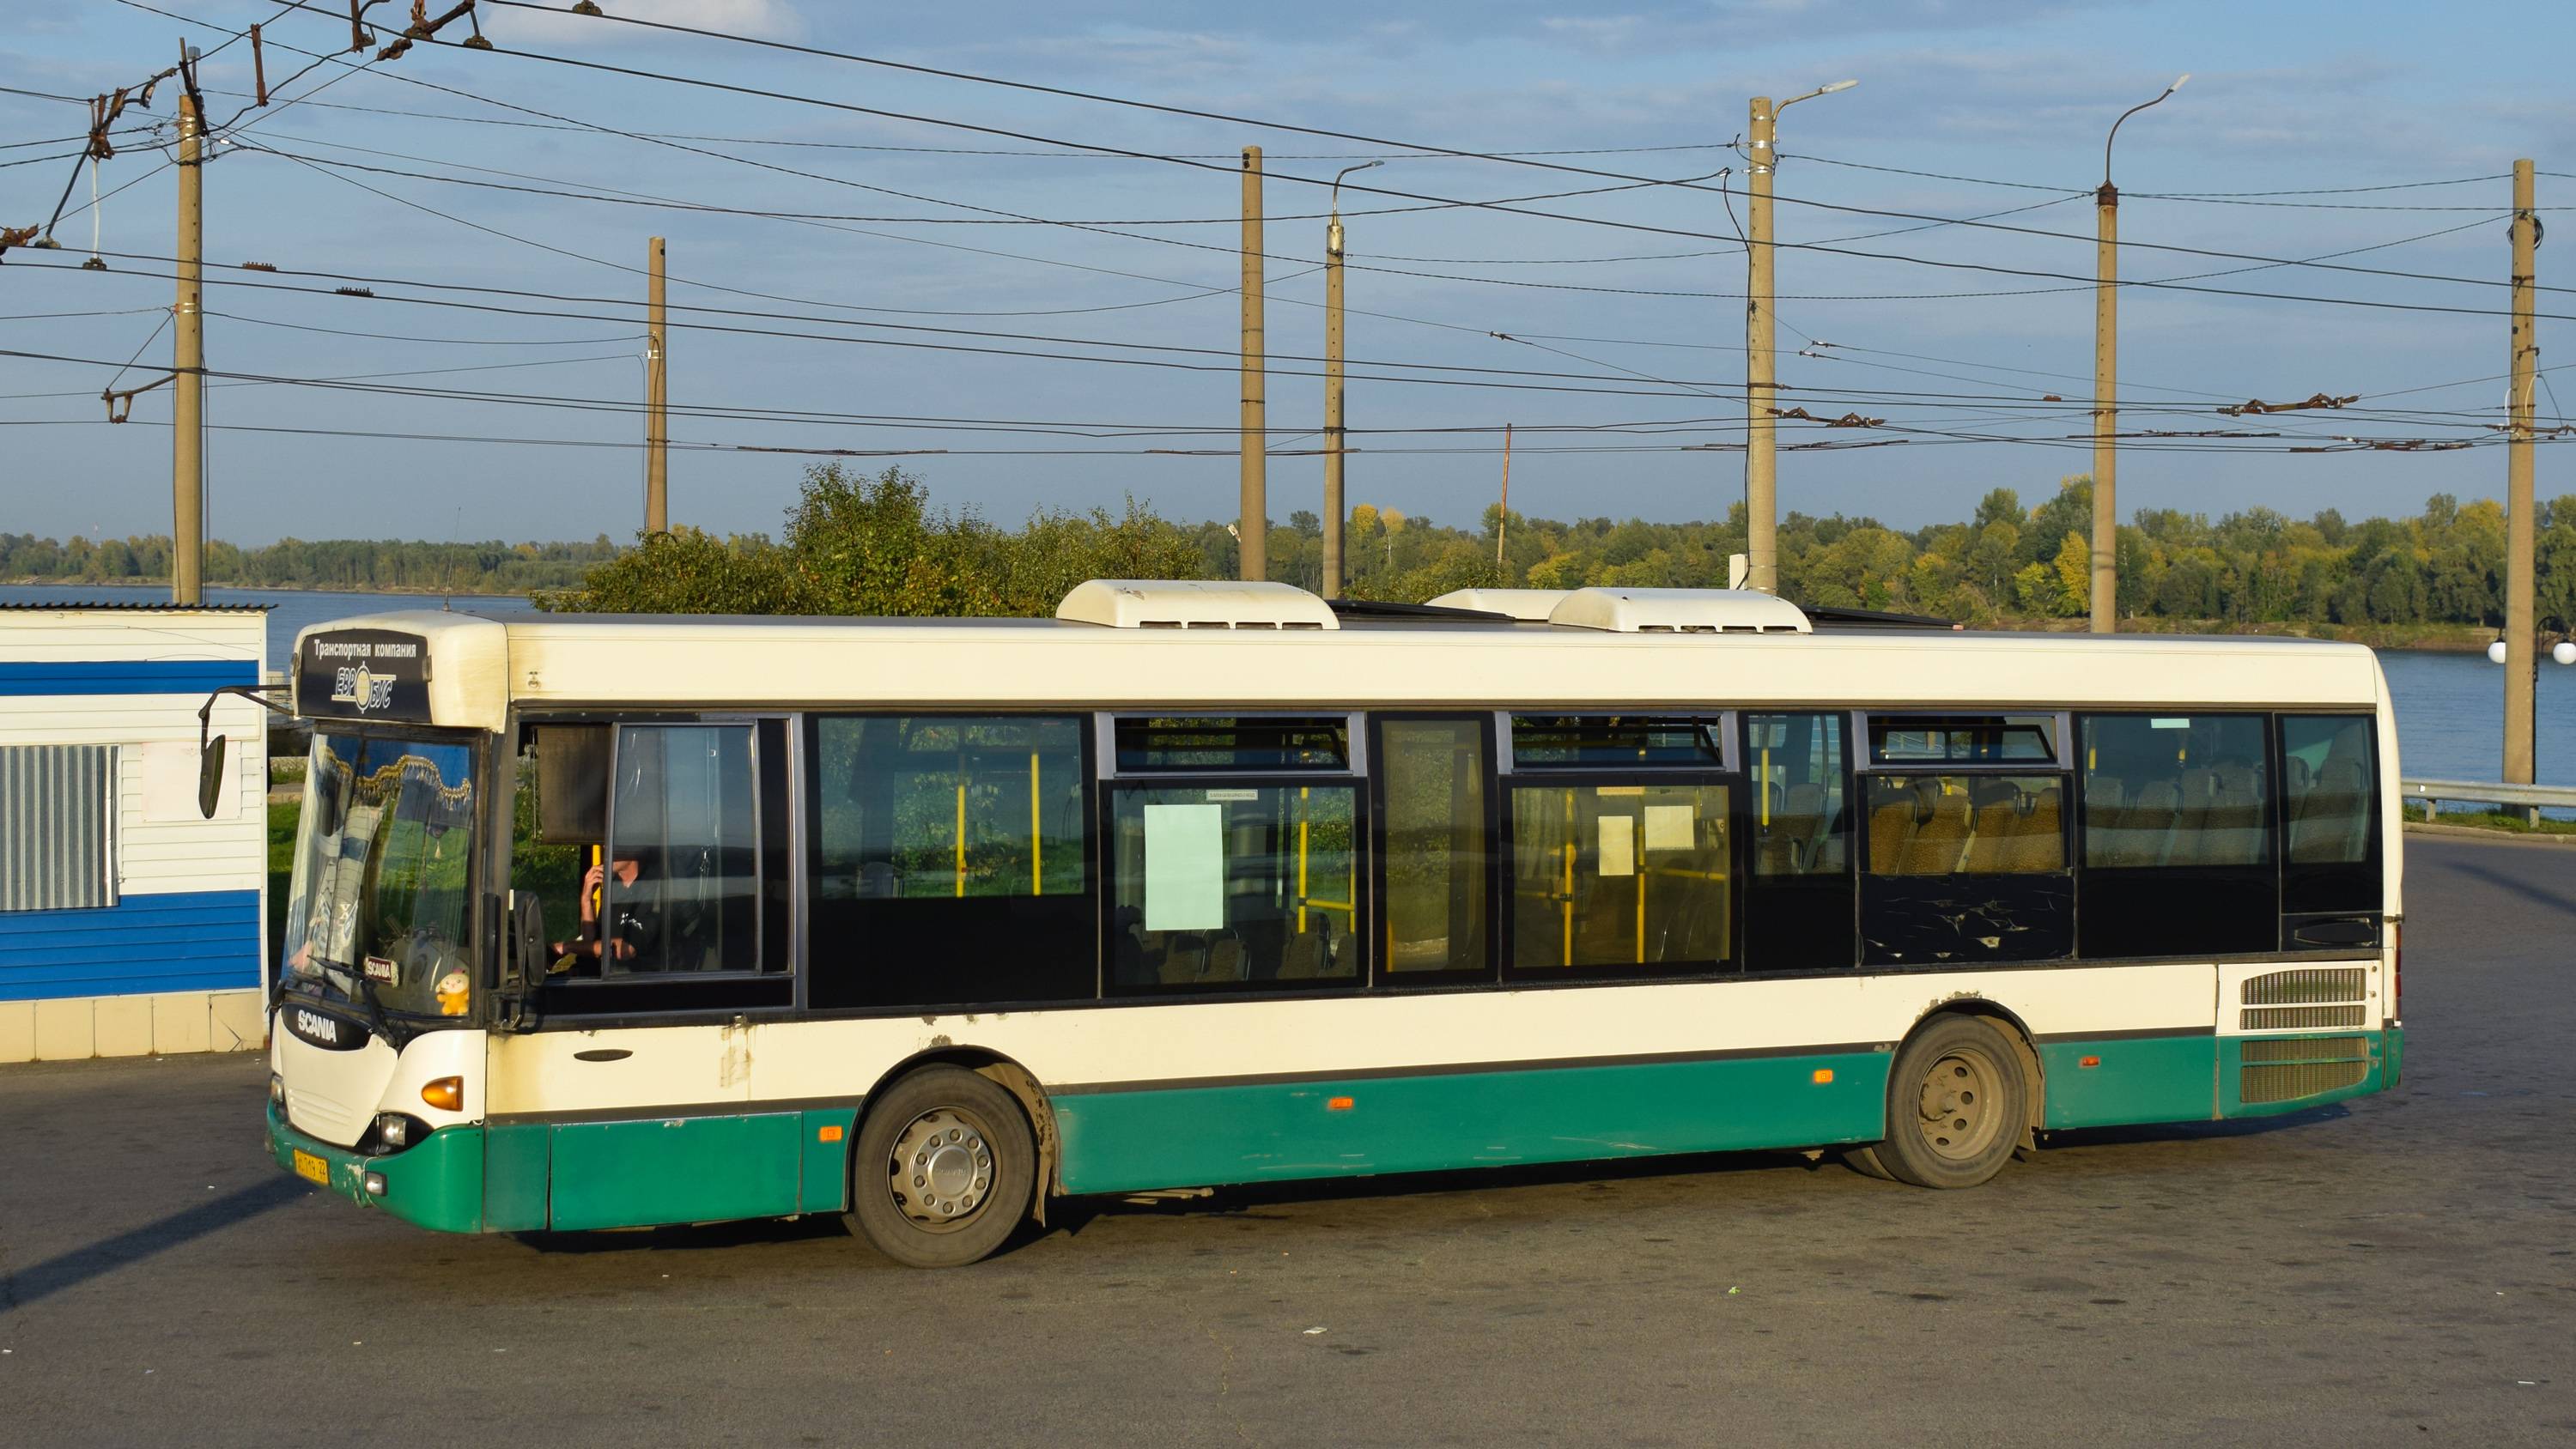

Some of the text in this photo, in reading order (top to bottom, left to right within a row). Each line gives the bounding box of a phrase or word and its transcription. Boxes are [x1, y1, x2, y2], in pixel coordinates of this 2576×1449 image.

[314, 640, 416, 660] Транспортная компания
[368, 961, 391, 979] SCANIA
[298, 1009, 337, 1043] SCANIA
